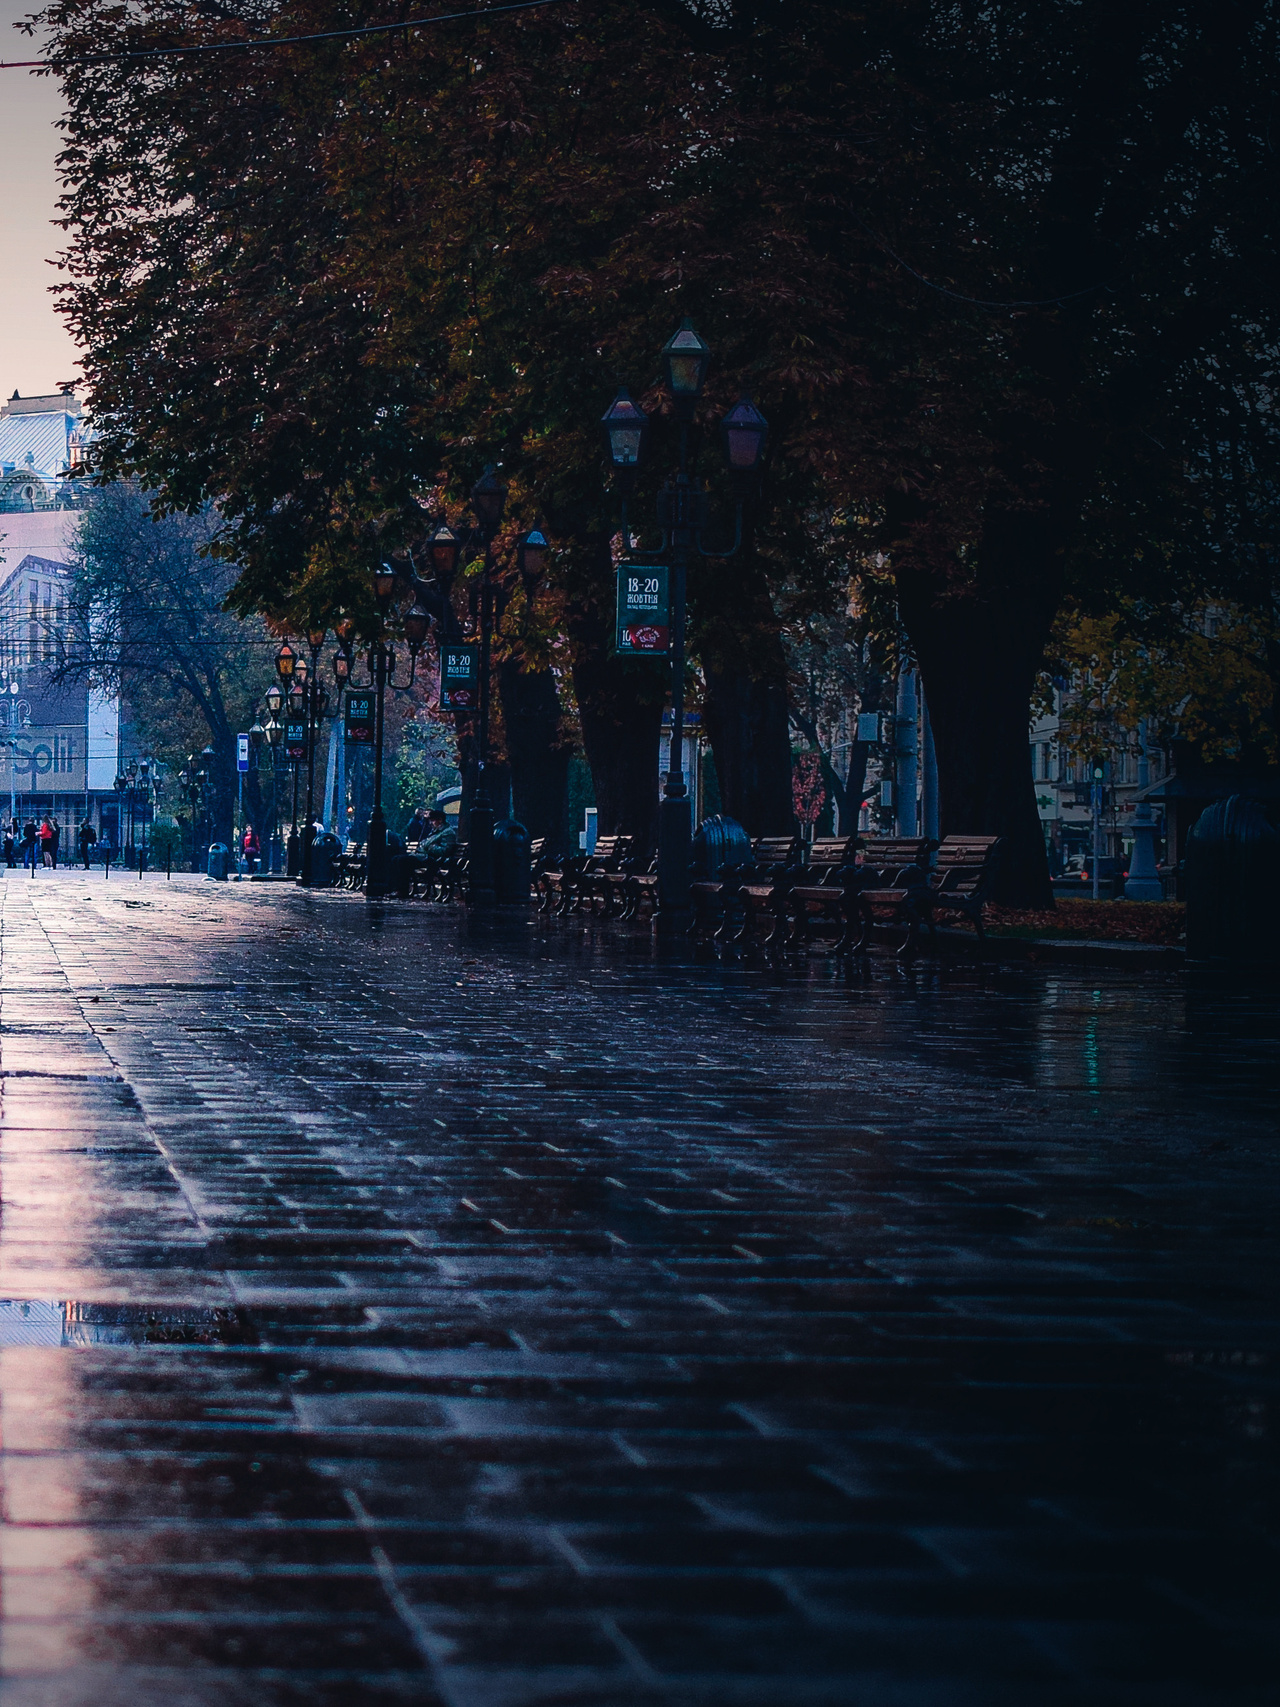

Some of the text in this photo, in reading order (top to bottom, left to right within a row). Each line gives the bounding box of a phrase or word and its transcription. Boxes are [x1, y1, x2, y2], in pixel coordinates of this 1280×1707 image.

[628, 577, 659, 593] 18-20
[627, 593, 658, 604] ЖОВТНЯ
[448, 654, 470, 666] 18-20
[14, 733, 77, 790] Split
